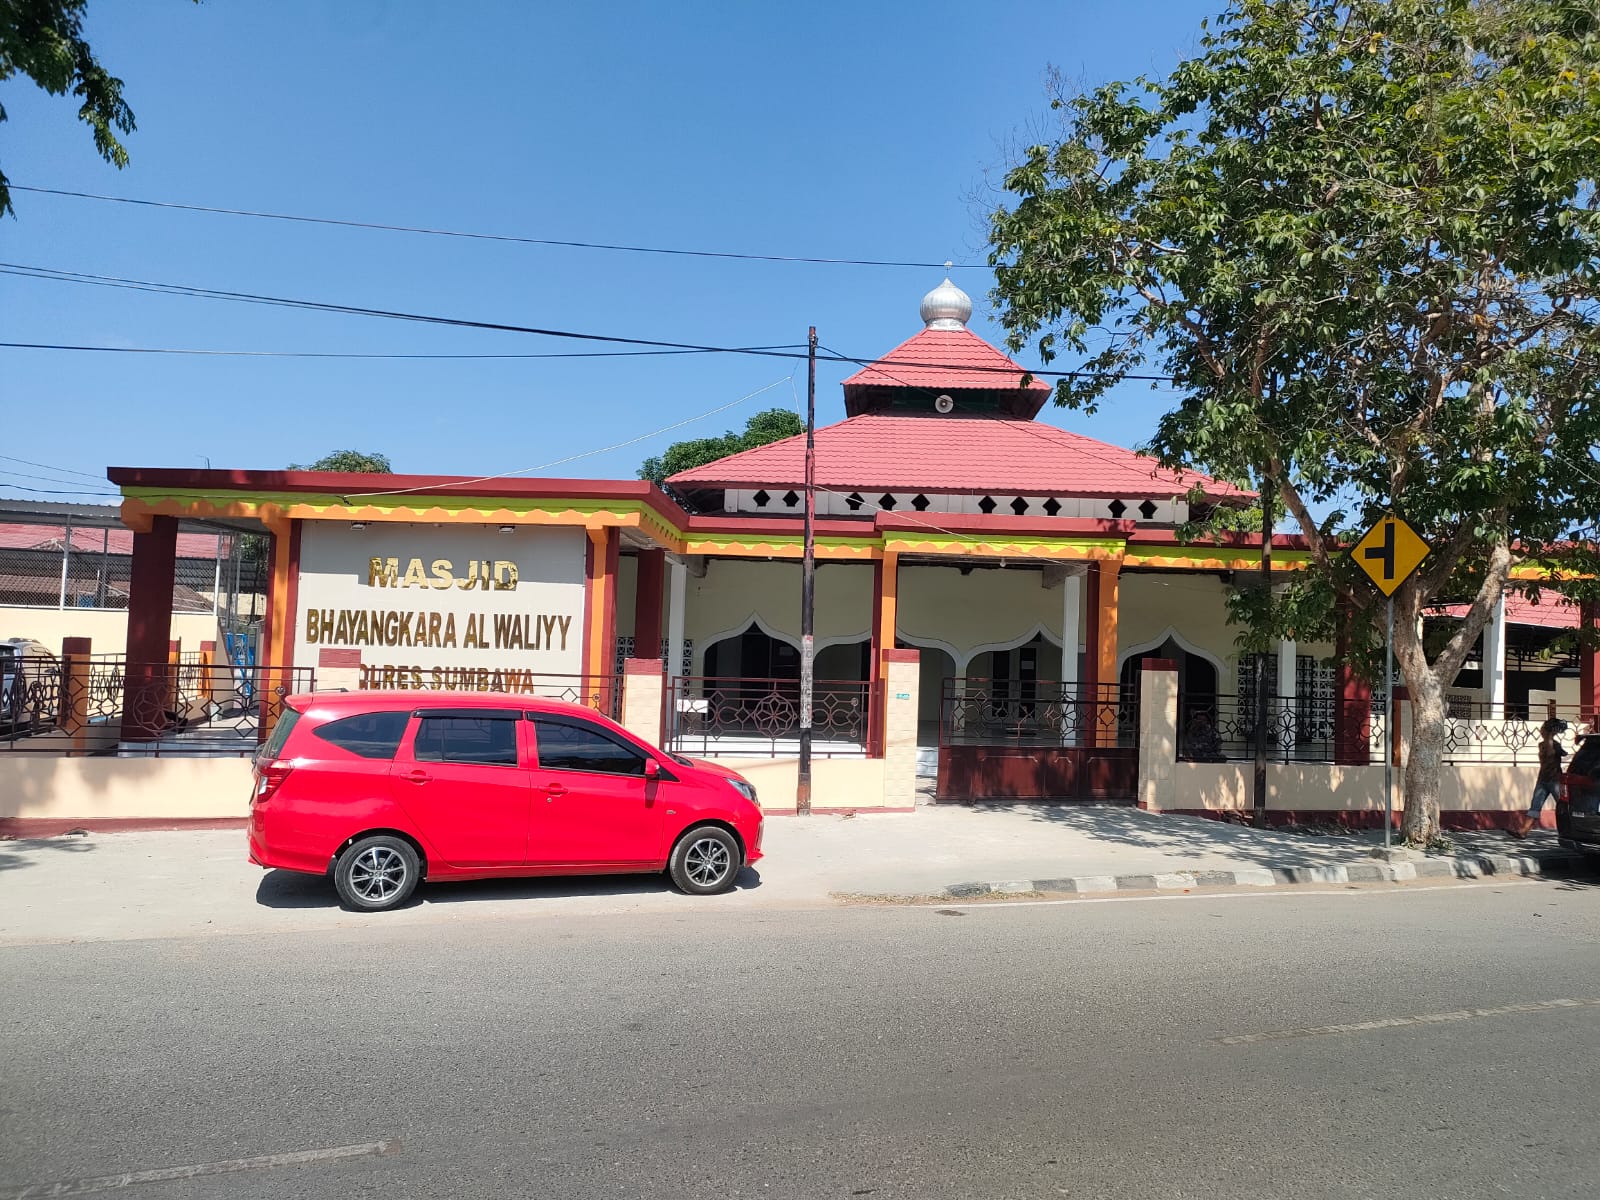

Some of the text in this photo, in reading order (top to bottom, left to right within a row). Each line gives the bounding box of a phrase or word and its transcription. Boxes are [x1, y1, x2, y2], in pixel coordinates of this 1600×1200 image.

[367, 556, 520, 592] MASJID
[305, 608, 573, 652] BHAYANGKARA AL WALIYY
[359, 663, 536, 694] OLRES SUMBAWA
